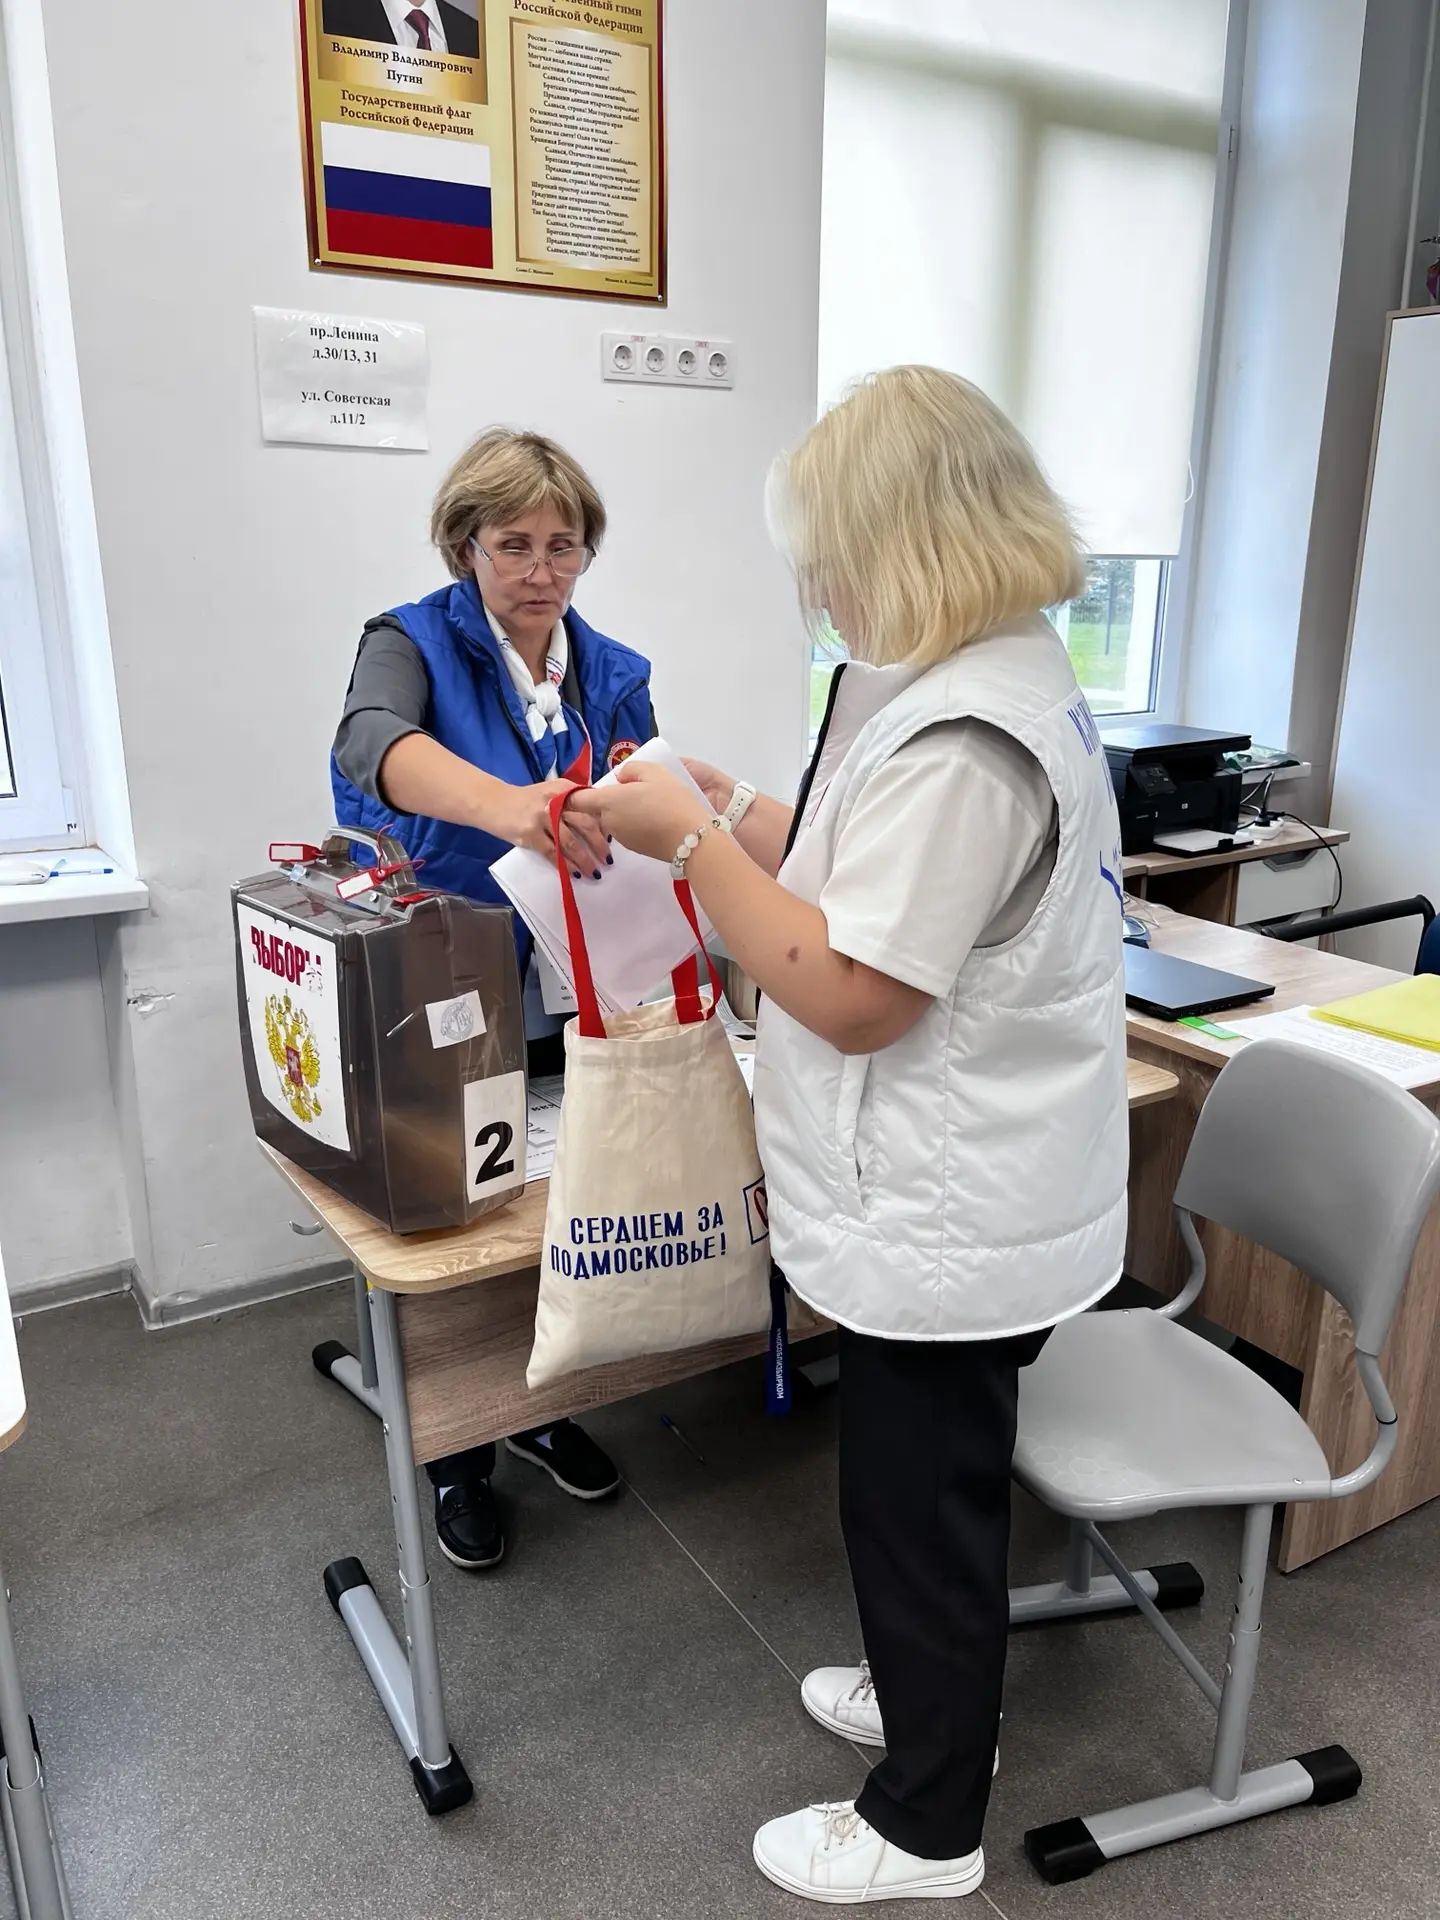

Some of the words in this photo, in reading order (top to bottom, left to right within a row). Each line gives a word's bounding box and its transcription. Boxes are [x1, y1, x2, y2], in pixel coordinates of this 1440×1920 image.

[514, 0, 581, 21] Российской
[584, 12, 643, 34] Федерации
[615, 5, 642, 17] гимн
[332, 42, 389, 63] Владимир
[392, 51, 473, 75] Владимирович
[387, 69, 423, 84] Путин
[341, 89, 443, 115] Государственный
[446, 106, 472, 120] флаг
[340, 106, 410, 126] Российской
[412, 116, 474, 136] Федерации
[310, 327, 379, 343] пр.Ленина
[312, 347, 361, 363] д.30/13,
[364, 351, 377, 363] 31
[301, 391, 320, 403] ул.
[324, 389, 391, 407] Советская
[330, 412, 366, 425] д.11/2
[251, 925, 321, 987] ВЫБОР
[474, 1121, 514, 1185] 2
[570, 1211, 683, 1245] СЕРДЦЕМ
[697, 1202, 724, 1232] ЗА
[551, 1232, 727, 1280] ПОДМОСКОВЬЕ!
